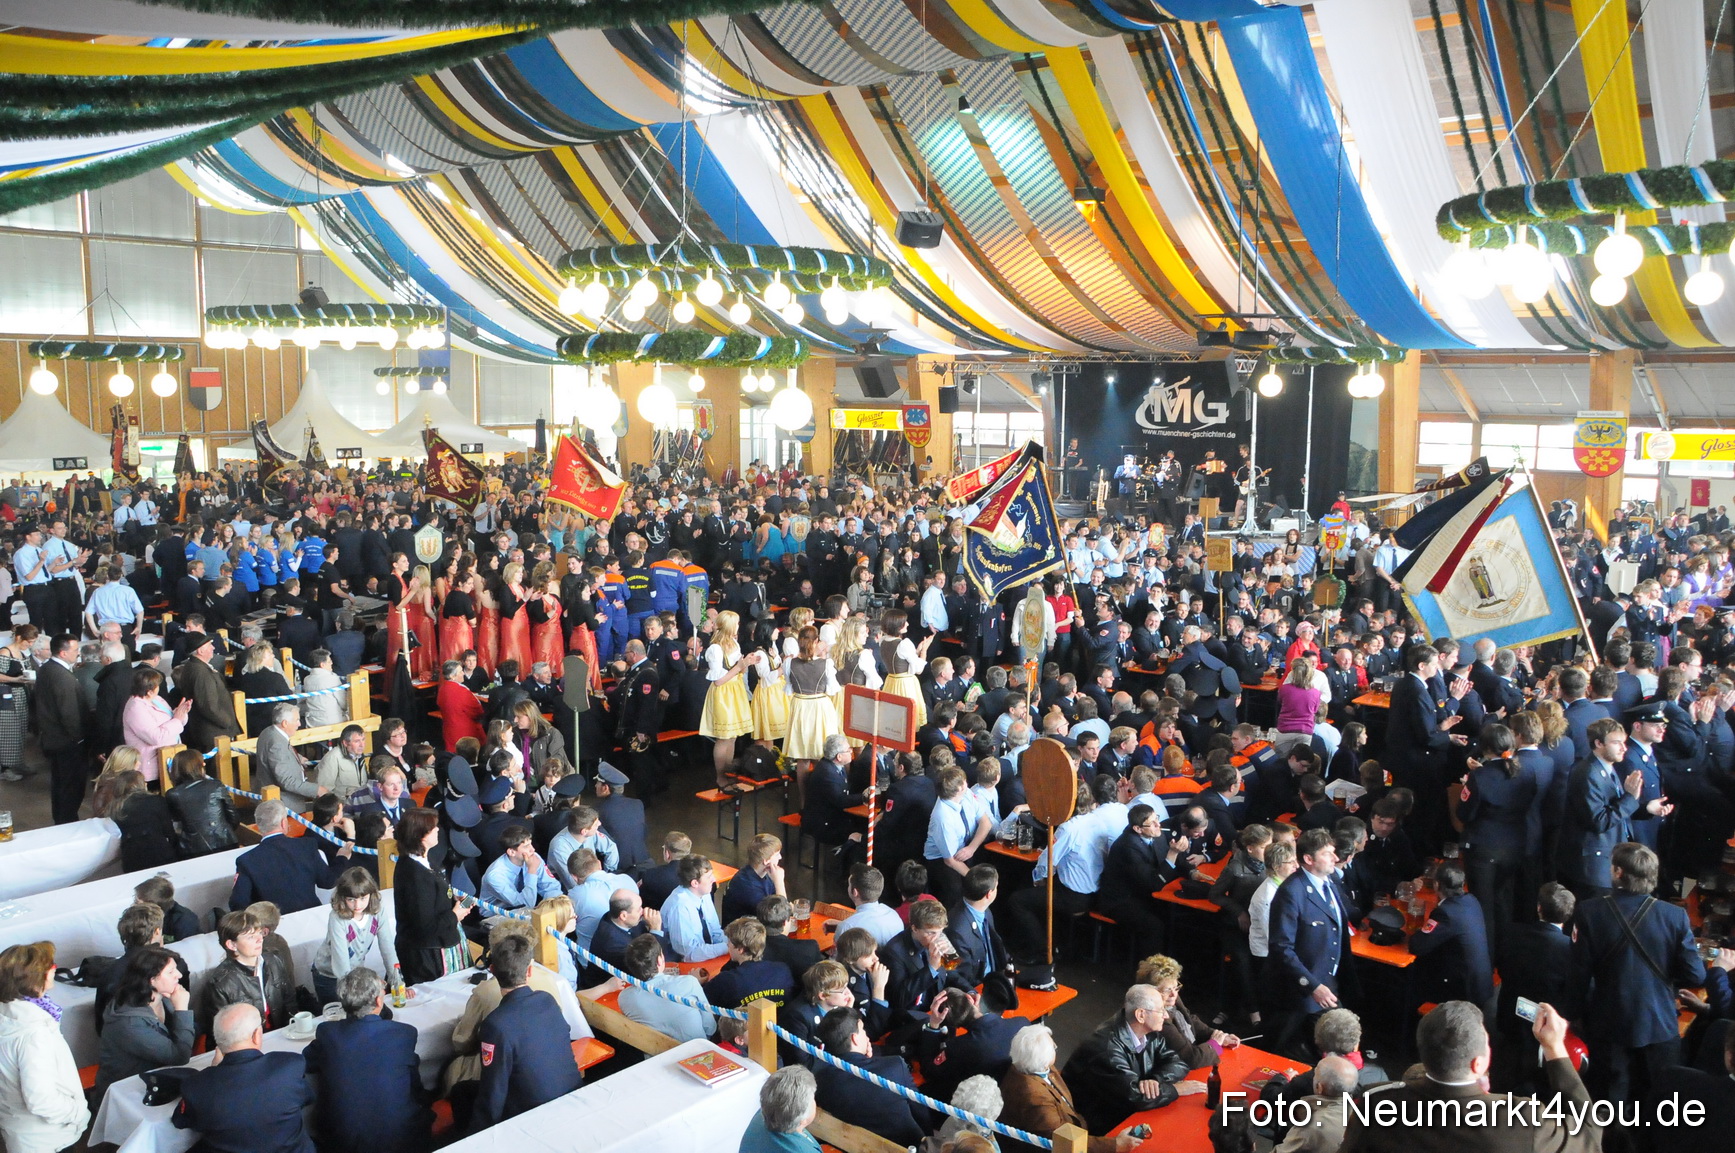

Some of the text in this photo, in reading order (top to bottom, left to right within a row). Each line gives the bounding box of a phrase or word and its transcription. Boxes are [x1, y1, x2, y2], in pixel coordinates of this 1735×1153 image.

[857, 411, 885, 428] Glossner
[1142, 428, 1236, 439] www.muenchner-gschichten.de
[1701, 438, 1735, 460] Glos
[55, 459, 86, 469] BAR
[740, 988, 785, 1006] FEUERWEHR
